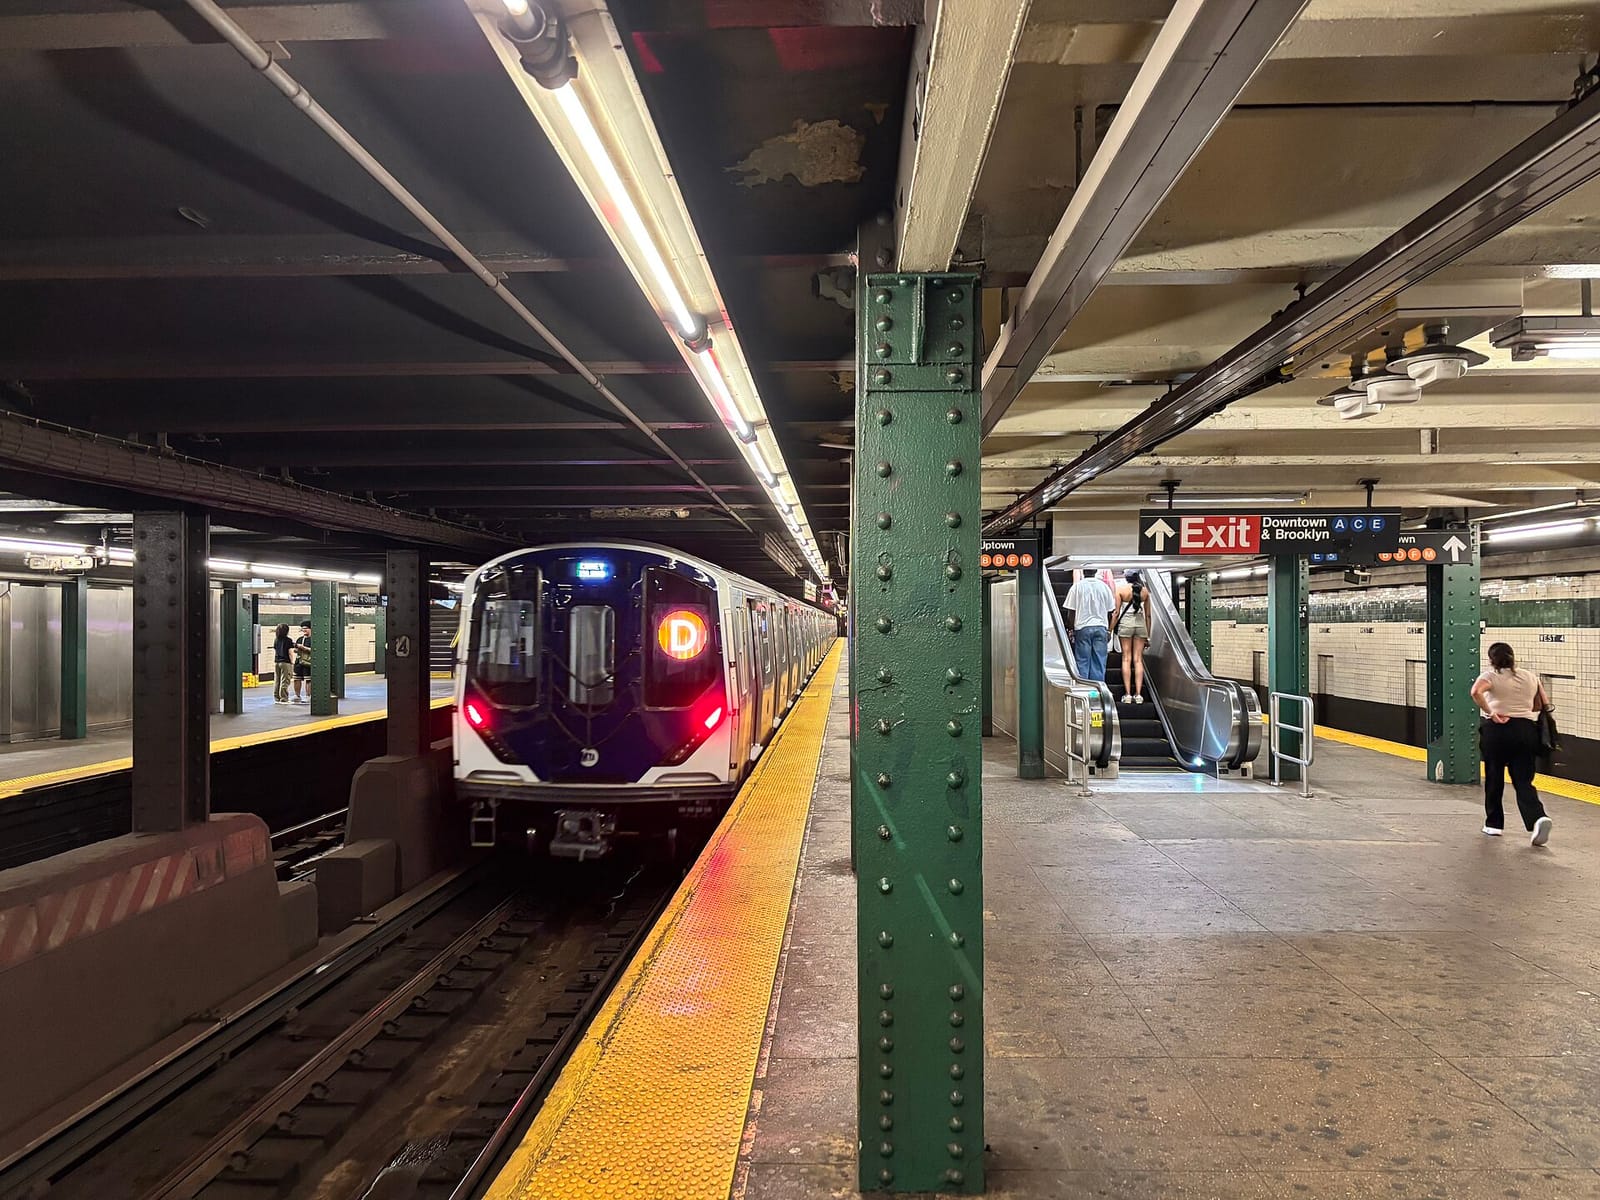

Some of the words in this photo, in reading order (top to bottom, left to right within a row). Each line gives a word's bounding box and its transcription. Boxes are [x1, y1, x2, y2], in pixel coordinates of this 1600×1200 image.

[1180, 517, 1250, 548] Exit
[1262, 517, 1327, 528] Downtown
[1335, 518, 1345, 529] A
[1354, 518, 1363, 529] C
[1373, 518, 1381, 529] E
[1261, 530, 1270, 540] &
[1275, 529, 1330, 541] Brooklyn
[669, 619, 698, 652] D
